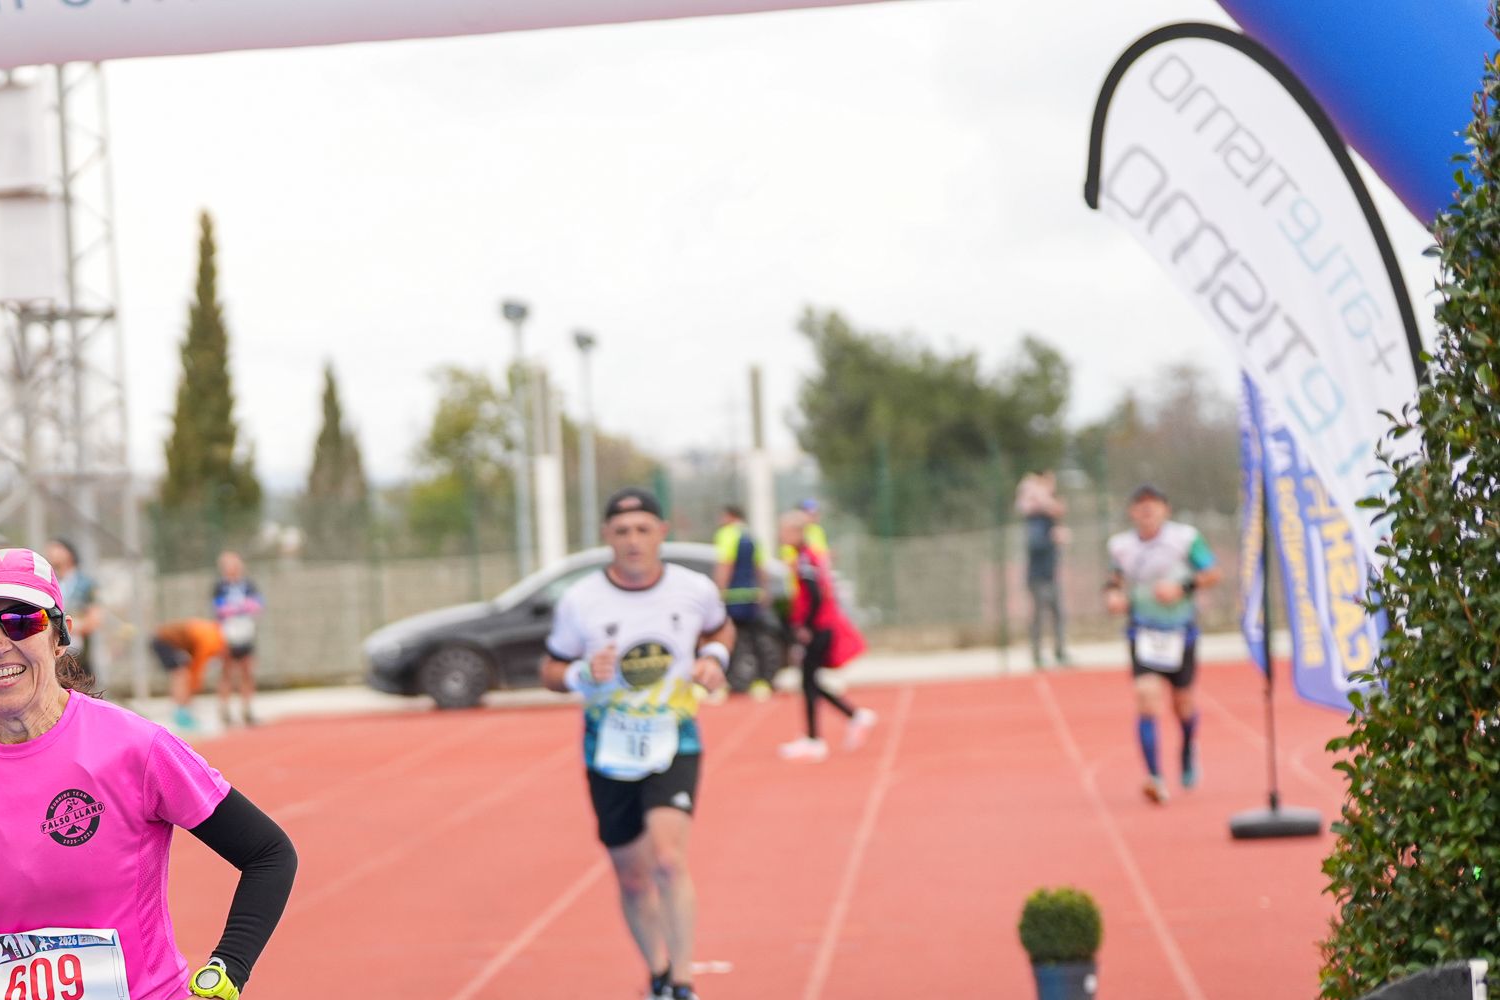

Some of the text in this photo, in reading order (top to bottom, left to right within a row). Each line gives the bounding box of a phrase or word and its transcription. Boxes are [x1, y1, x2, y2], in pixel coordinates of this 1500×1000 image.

[41, 803, 103, 831] FALSO LLANO
[58, 935, 77, 947] 2026
